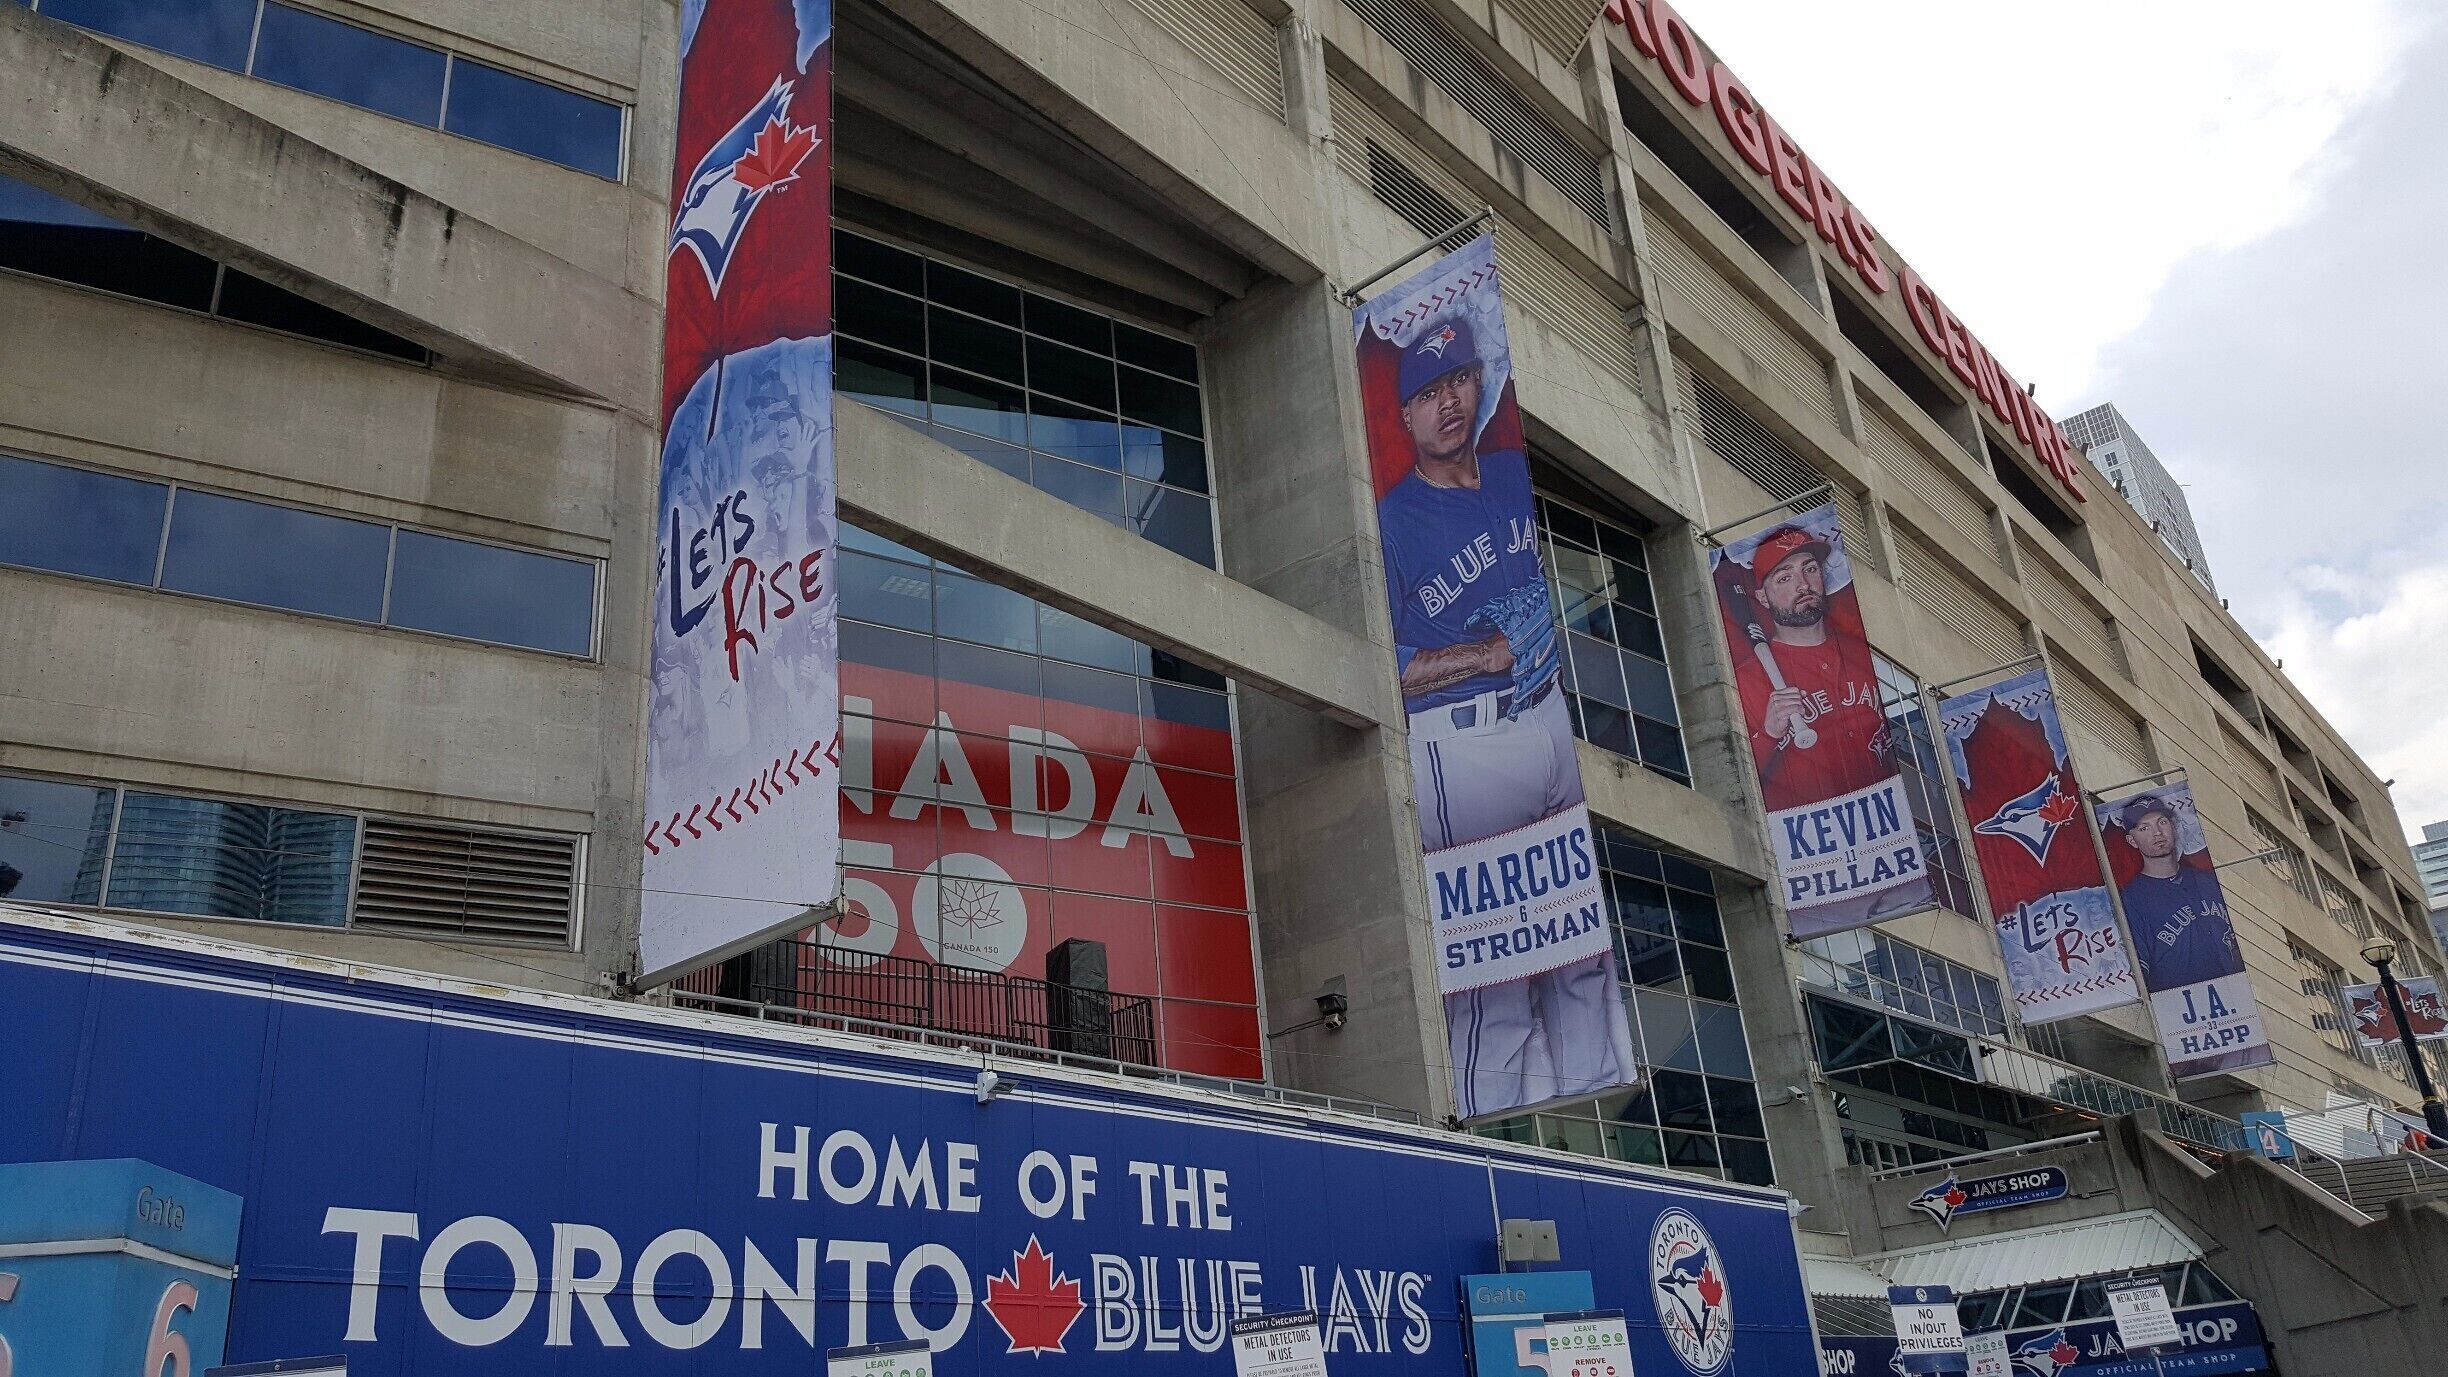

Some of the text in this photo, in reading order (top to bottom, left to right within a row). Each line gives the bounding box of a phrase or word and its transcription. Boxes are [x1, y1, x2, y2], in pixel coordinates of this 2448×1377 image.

[1900, 267, 2087, 503] CENTRE
[1418, 515, 1544, 618] BLUE JA
[1783, 787, 1900, 860] KEVIN
[1845, 850, 1858, 863] 11
[1435, 827, 1591, 920] MARCUS
[1788, 847, 1919, 902] PILLAR
[1519, 905, 1528, 923] 6
[2157, 905, 2197, 947] BLUE
[1446, 901, 1600, 969] STROMAN
[943, 942, 999, 954] CANADA 150
[2182, 984, 2237, 1024] J.A.
[2208, 1021, 2218, 1031] 33
[2181, 1024, 2251, 1055] HAPP
[2263, 1129, 2280, 1154] 4
[757, 1122, 1233, 1231] HOME OF THE
[1972, 1173, 2050, 1198] JAYS SHOP
[137, 1186, 185, 1232] Gate
[1656, 1220, 1699, 1270] TORONTO
[321, 1206, 974, 1353] TORONTO
[1090, 1253, 1263, 1352] BLUE
[2107, 1281, 2131, 1290] SECURITY
[1477, 1286, 1527, 1303] Gate
[2115, 1289, 2160, 1304] METAL DETECTORS
[1235, 1314, 1314, 1332] SECURITY CHECKPOINT
[1917, 1308, 1934, 1320] NO
[1243, 1329, 1311, 1350] METAL DETECTORS
[1909, 1322, 1947, 1336] IN/OUT
[2088, 1331, 2126, 1357] JA
[2175, 1317, 2238, 1347] HOP
[1267, 1347, 1293, 1362] IN USE
[1901, 1337, 1963, 1350] PRIVILEGES
[865, 1359, 896, 1369] LEAVE
[1575, 1358, 1606, 1366] REMOVE
[2097, 1353, 2236, 1376] OFFICIAL TEAM SHOP
